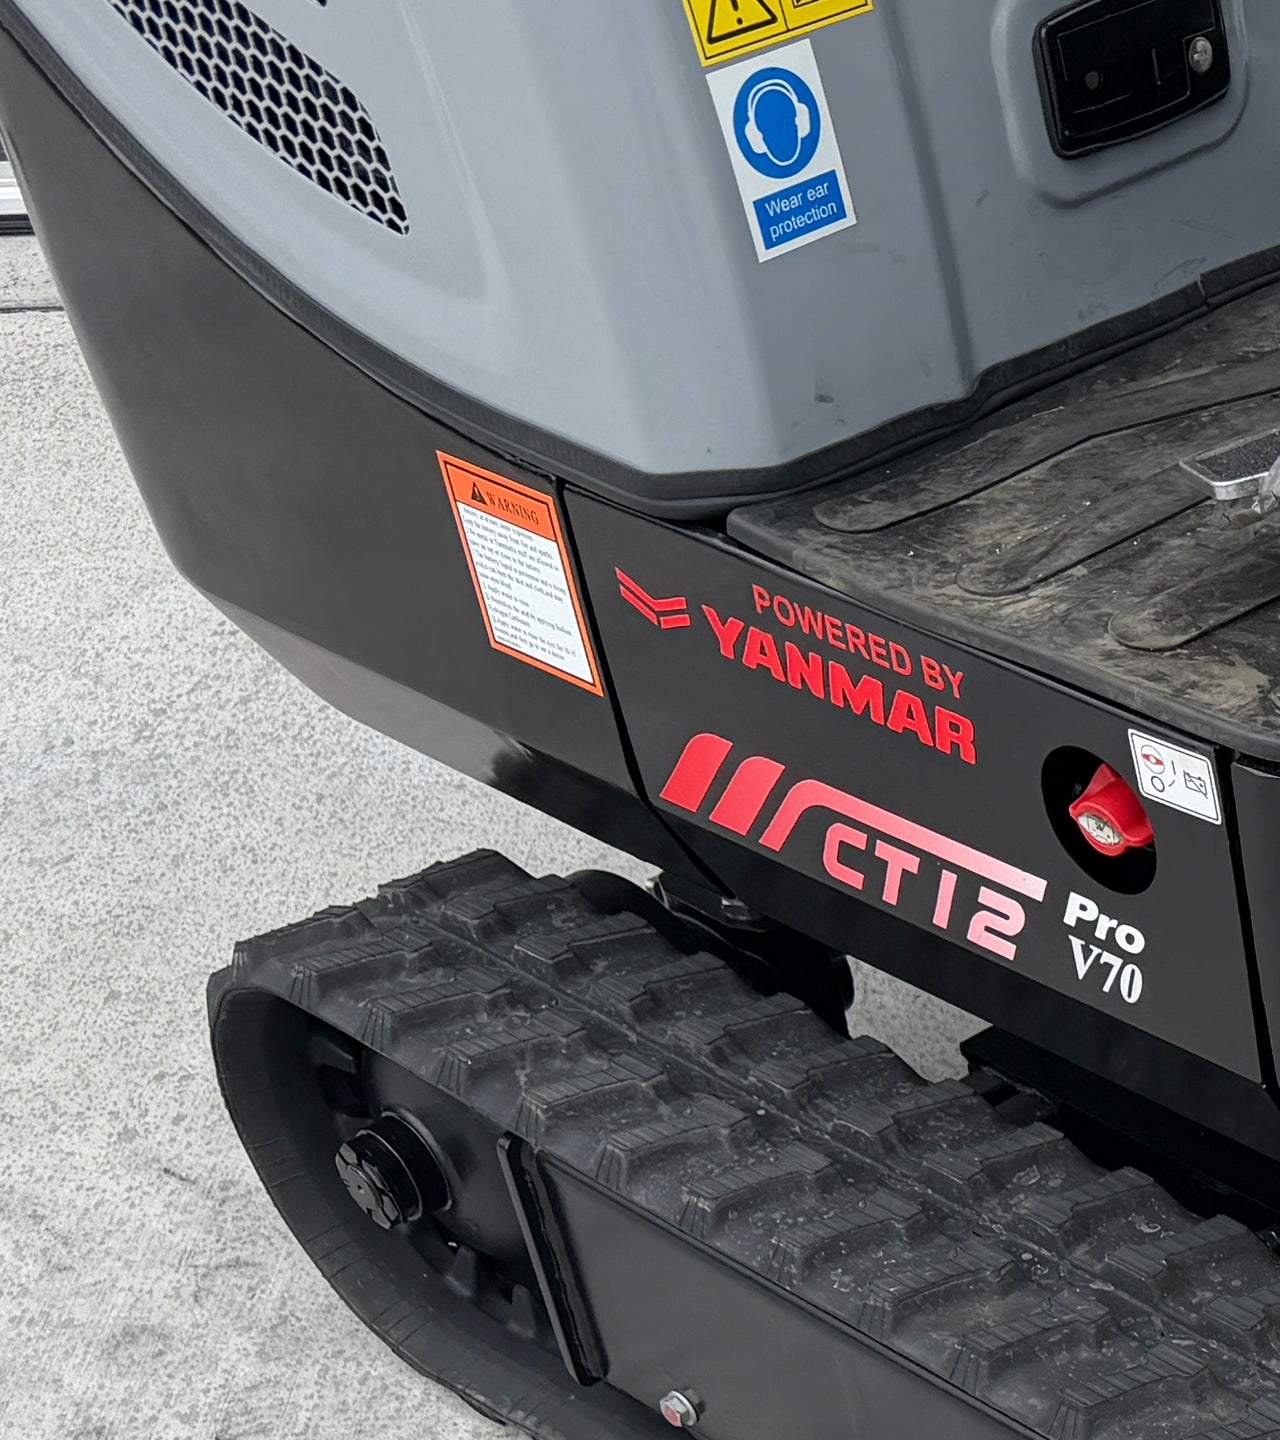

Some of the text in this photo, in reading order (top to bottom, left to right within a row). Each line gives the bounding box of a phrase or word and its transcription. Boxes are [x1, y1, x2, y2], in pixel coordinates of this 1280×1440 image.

[764, 182, 829, 217] Wear ear
[769, 202, 838, 242] protection
[485, 491, 539, 525] WARNING
[751, 583, 964, 700] POWERED BY
[700, 603, 978, 766] YANMAR
[822, 821, 1027, 962] CT12
[1061, 890, 1147, 956] Pro
[1066, 933, 1144, 1005] V70
